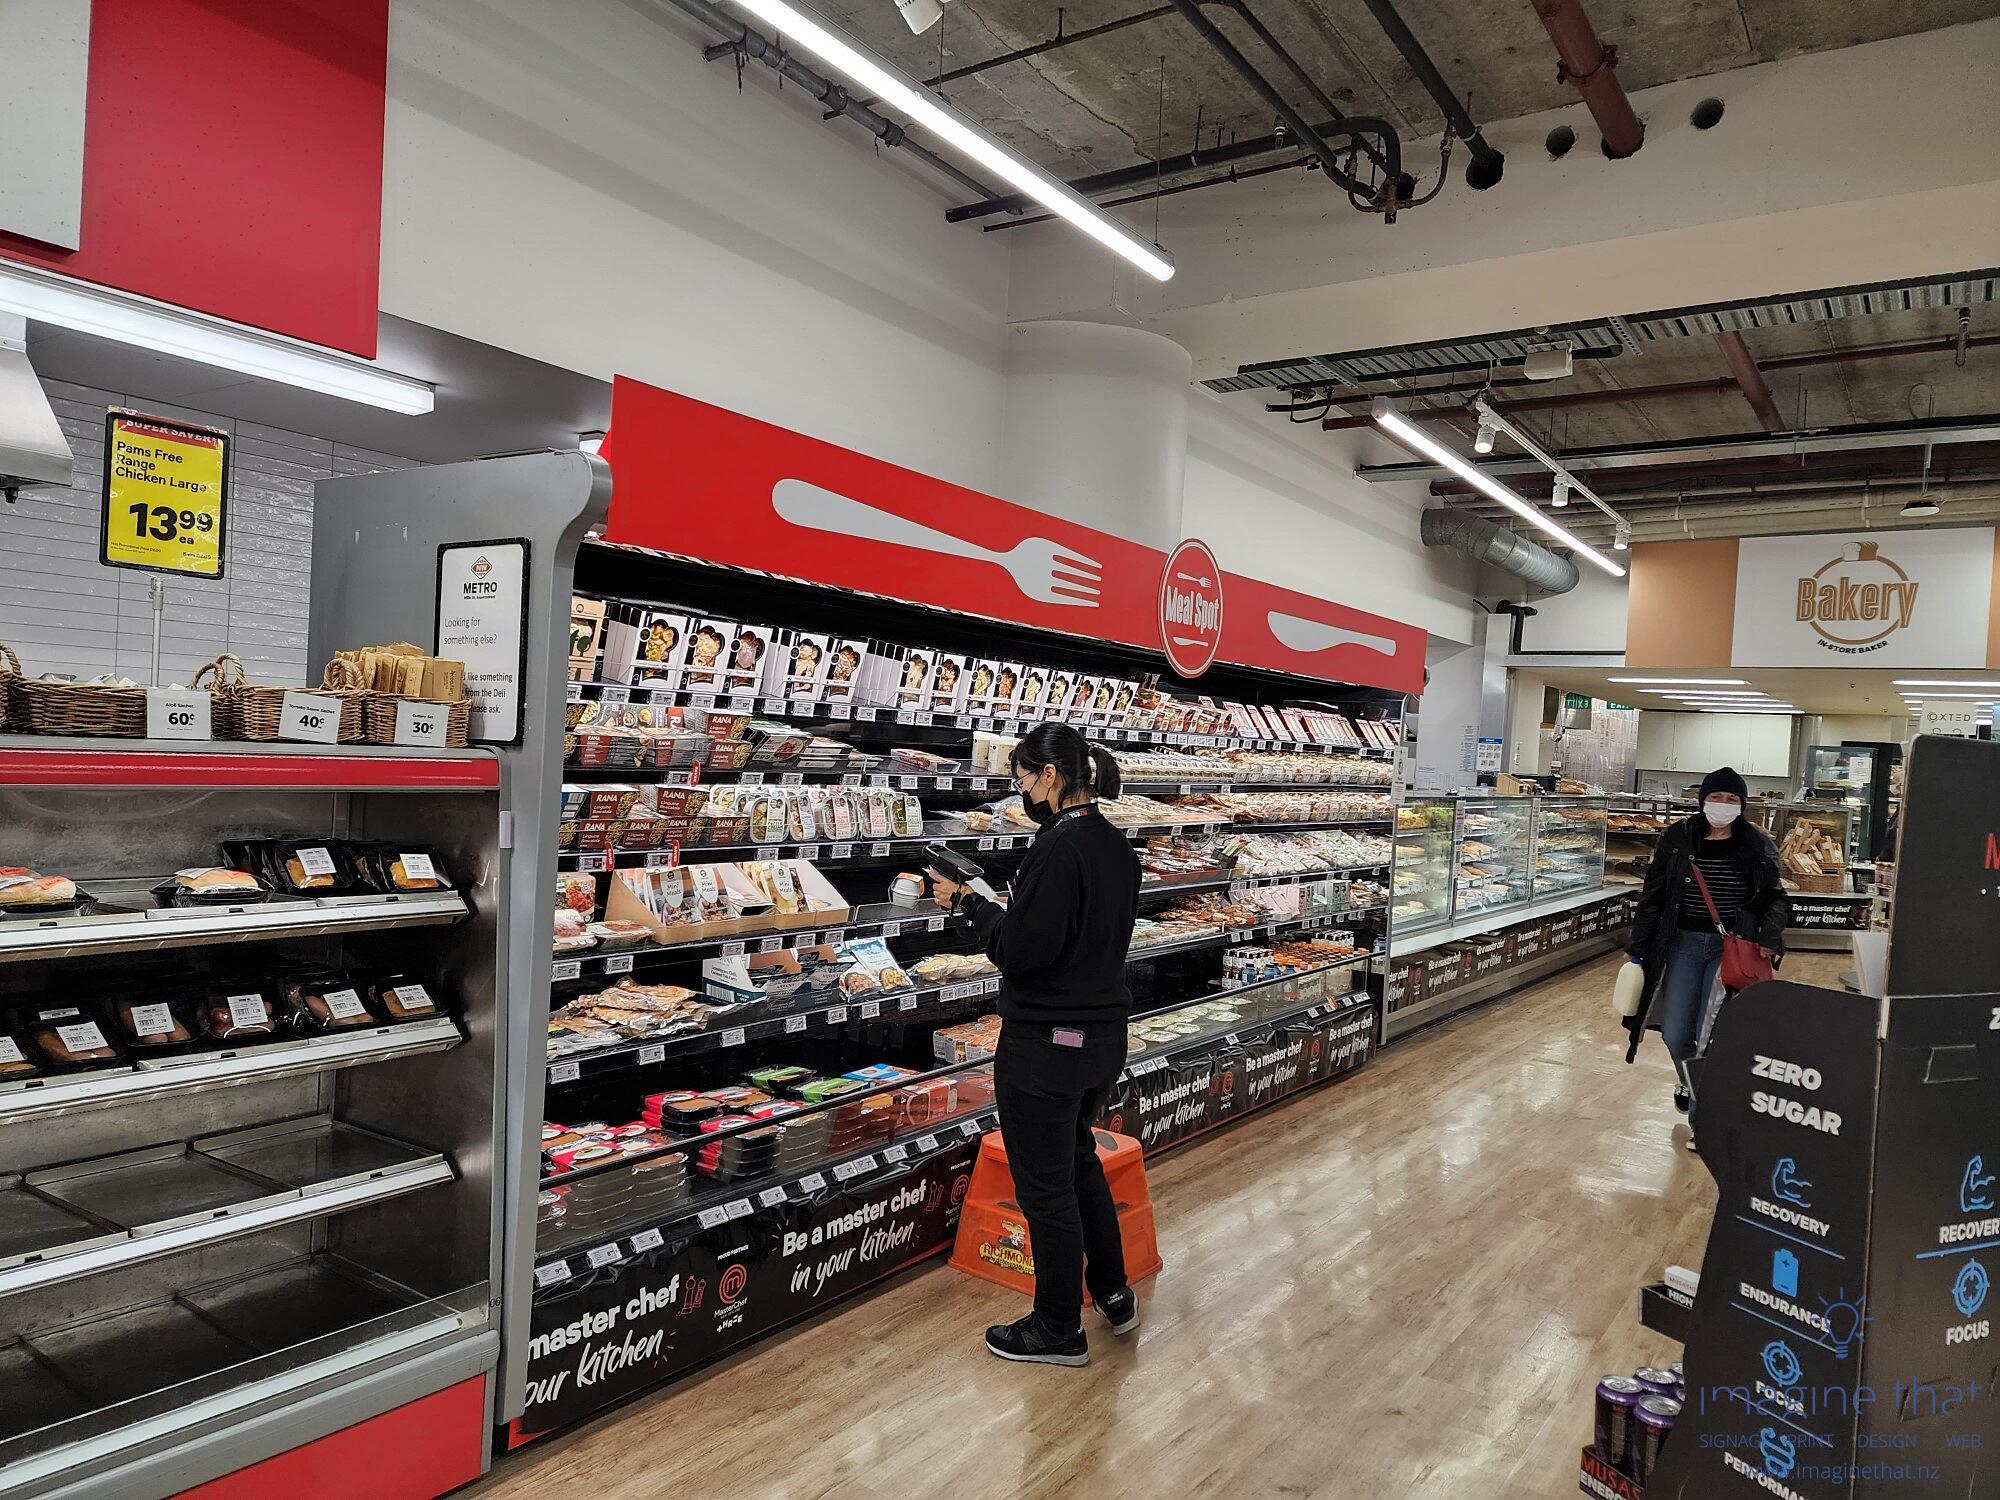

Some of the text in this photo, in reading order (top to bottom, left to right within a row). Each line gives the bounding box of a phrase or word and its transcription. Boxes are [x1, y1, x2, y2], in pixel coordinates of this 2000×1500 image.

[116, 455, 156, 471] Range
[117, 441, 183, 463] Pams Free
[116, 466, 207, 492] Chicken Large
[179, 536, 194, 546] ea
[463, 581, 498, 594] METRO
[1165, 585, 1219, 635] Meal Spot
[1796, 577, 1920, 629] Bakery
[444, 616, 481, 629] Looking for
[444, 634, 498, 647] something else?
[1817, 638, 1889, 654] IN-STORE BAKER
[468, 672, 478, 681] like
[480, 672, 513, 684] something
[464, 688, 506, 698] from the Deli
[470, 705, 487, 713] lease
[711, 716, 732, 725] RANA
[715, 744, 734, 753] RANA
[596, 794, 618, 802] RANA
[663, 790, 685, 800] RANA
[584, 823, 606, 831] RANA
[630, 822, 650, 830] RANA
[669, 819, 688, 827] RANA
[716, 820, 734, 828] RANA
[1329, 1028, 1337, 1041] Be
[1342, 1019, 1360, 1037] master
[1360, 1013, 1373, 1030] chef
[1246, 1039, 1303, 1073] Be a master chef
[1331, 1047, 1338, 1062] in
[1336, 1043, 1351, 1066] your
[1352, 1034, 1370, 1054] kitchen
[1248, 1079, 1257, 1095] in
[1255, 1074, 1273, 1100] your
[1274, 1061, 1297, 1086] kitchen
[1752, 1055, 1822, 1091] ZERO
[1139, 1096, 1152, 1114] Be
[1153, 1095, 1159, 1108] a
[1160, 1082, 1191, 1106] master
[1191, 1071, 1211, 1093] chef
[1142, 1120, 1153, 1140] in
[1151, 1113, 1174, 1145] your
[1175, 1098, 1205, 1126] kitchen
[1751, 1091, 1842, 1136] SUGAR
[782, 1178, 927, 1257] Be a master chef
[1750, 1197, 1830, 1237] RECOVERY
[1939, 1217, 2000, 1244] RECOVER
[790, 1219, 915, 1297] in your kitchen
[714, 1296, 748, 1318] MasterChef
[1668, 1288, 1694, 1308] HIGH
[1740, 1282, 1831, 1334] ENDURANCE
[528, 1305, 621, 1362] master
[625, 1274, 680, 1320] chef
[1946, 1320, 1990, 1346] FOCUS
[525, 1329, 664, 1408] our kitchen
[1755, 1380, 1806, 1416] FOCUS
[1581, 1452, 1641, 1500] MUSAS
[1724, 1451, 1807, 1500] PERFORMA
